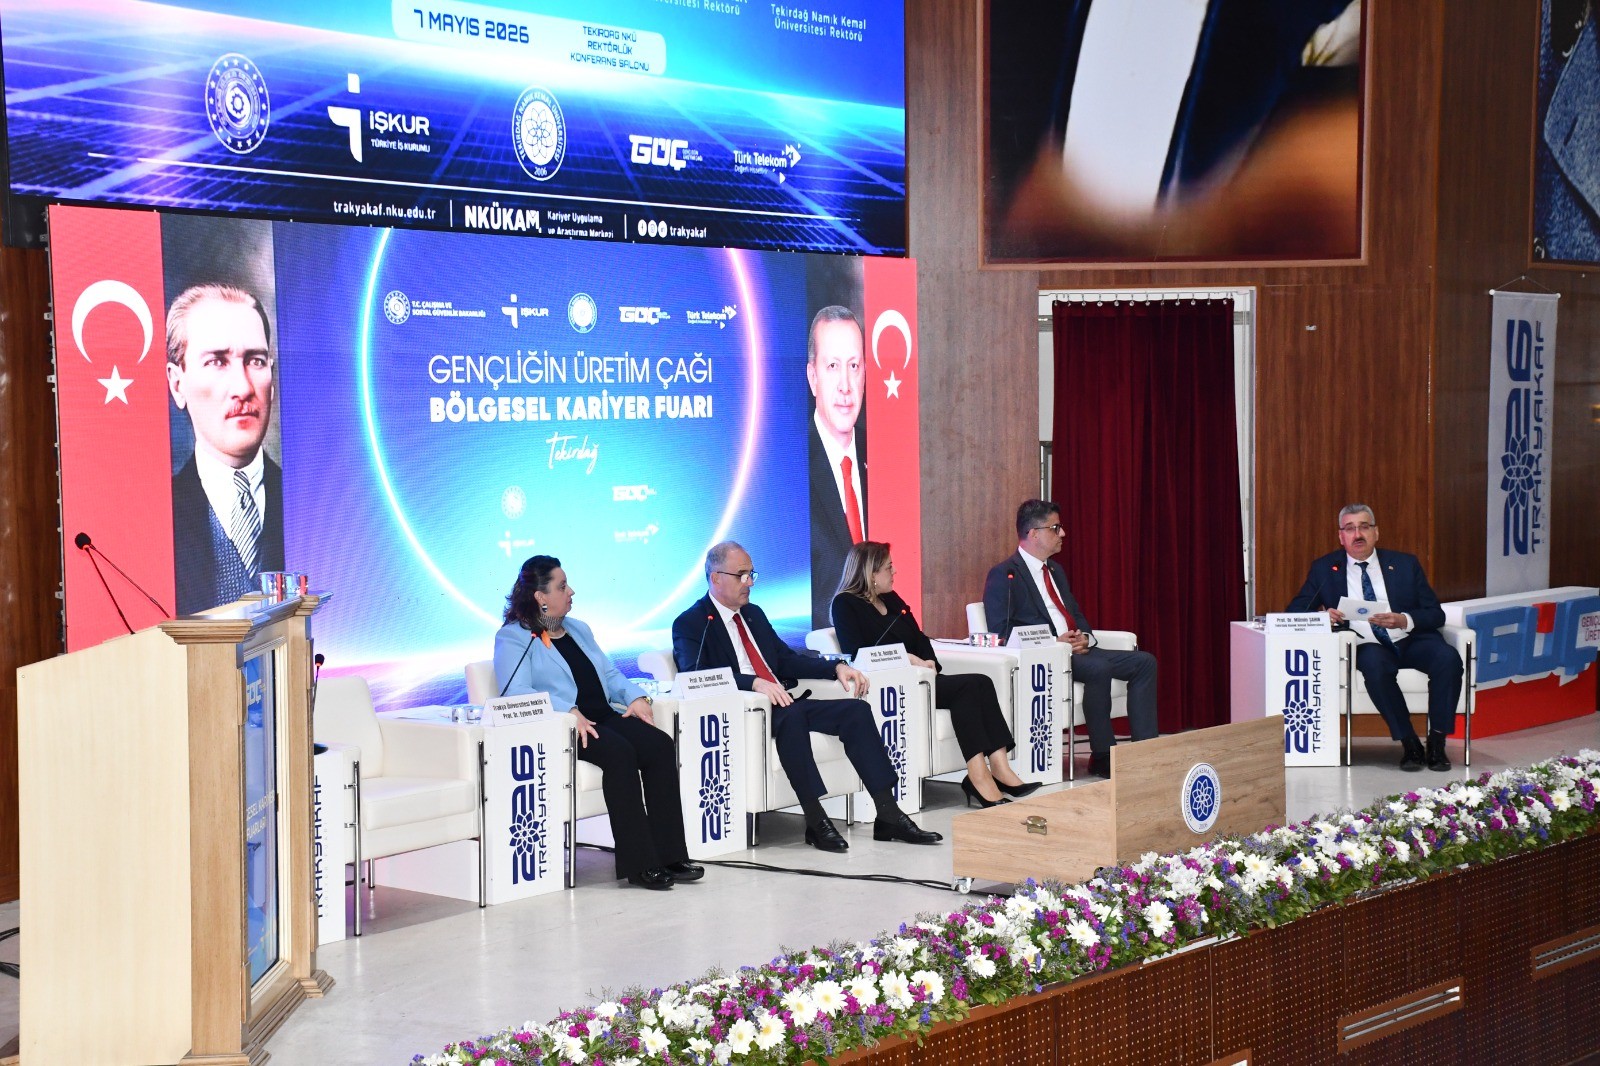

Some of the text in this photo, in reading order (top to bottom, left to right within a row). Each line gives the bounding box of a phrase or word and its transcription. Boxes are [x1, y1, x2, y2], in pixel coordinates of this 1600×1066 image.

[414, 9, 530, 44] 7 MAYIS 2026
[771, 4, 866, 30] Tekirdağ Namık Kemal
[774, 16, 863, 42] Üniversitesi Rektörü
[587, 41, 633, 55] REKTÖRLÜK
[622, 31, 637, 42] NKÜ
[570, 52, 650, 71] KONFERANS SALONU
[369, 110, 430, 136] İŞKUR
[404, 142, 430, 153] KURUMU
[733, 150, 788, 168] Türk Telekom
[333, 201, 437, 220] trakyakaf.nku.edu.tr
[464, 202, 542, 233] NKÜKAM
[547, 211, 603, 224] Kariyer Uygulama
[669, 225, 707, 239] trakyakaf
[428, 350, 713, 390] GENÇLİĞİN ÜRETİM ÇAĞI
[429, 389, 713, 423] BÖLGESEL KARİYER FUARI
[545, 431, 600, 475] Tekirdağ
[1312, 649, 1321, 753] TRAKYAKAF
[721, 712, 732, 839] TRAKYAKAF
[537, 742, 548, 879] TRAKYAKAF
